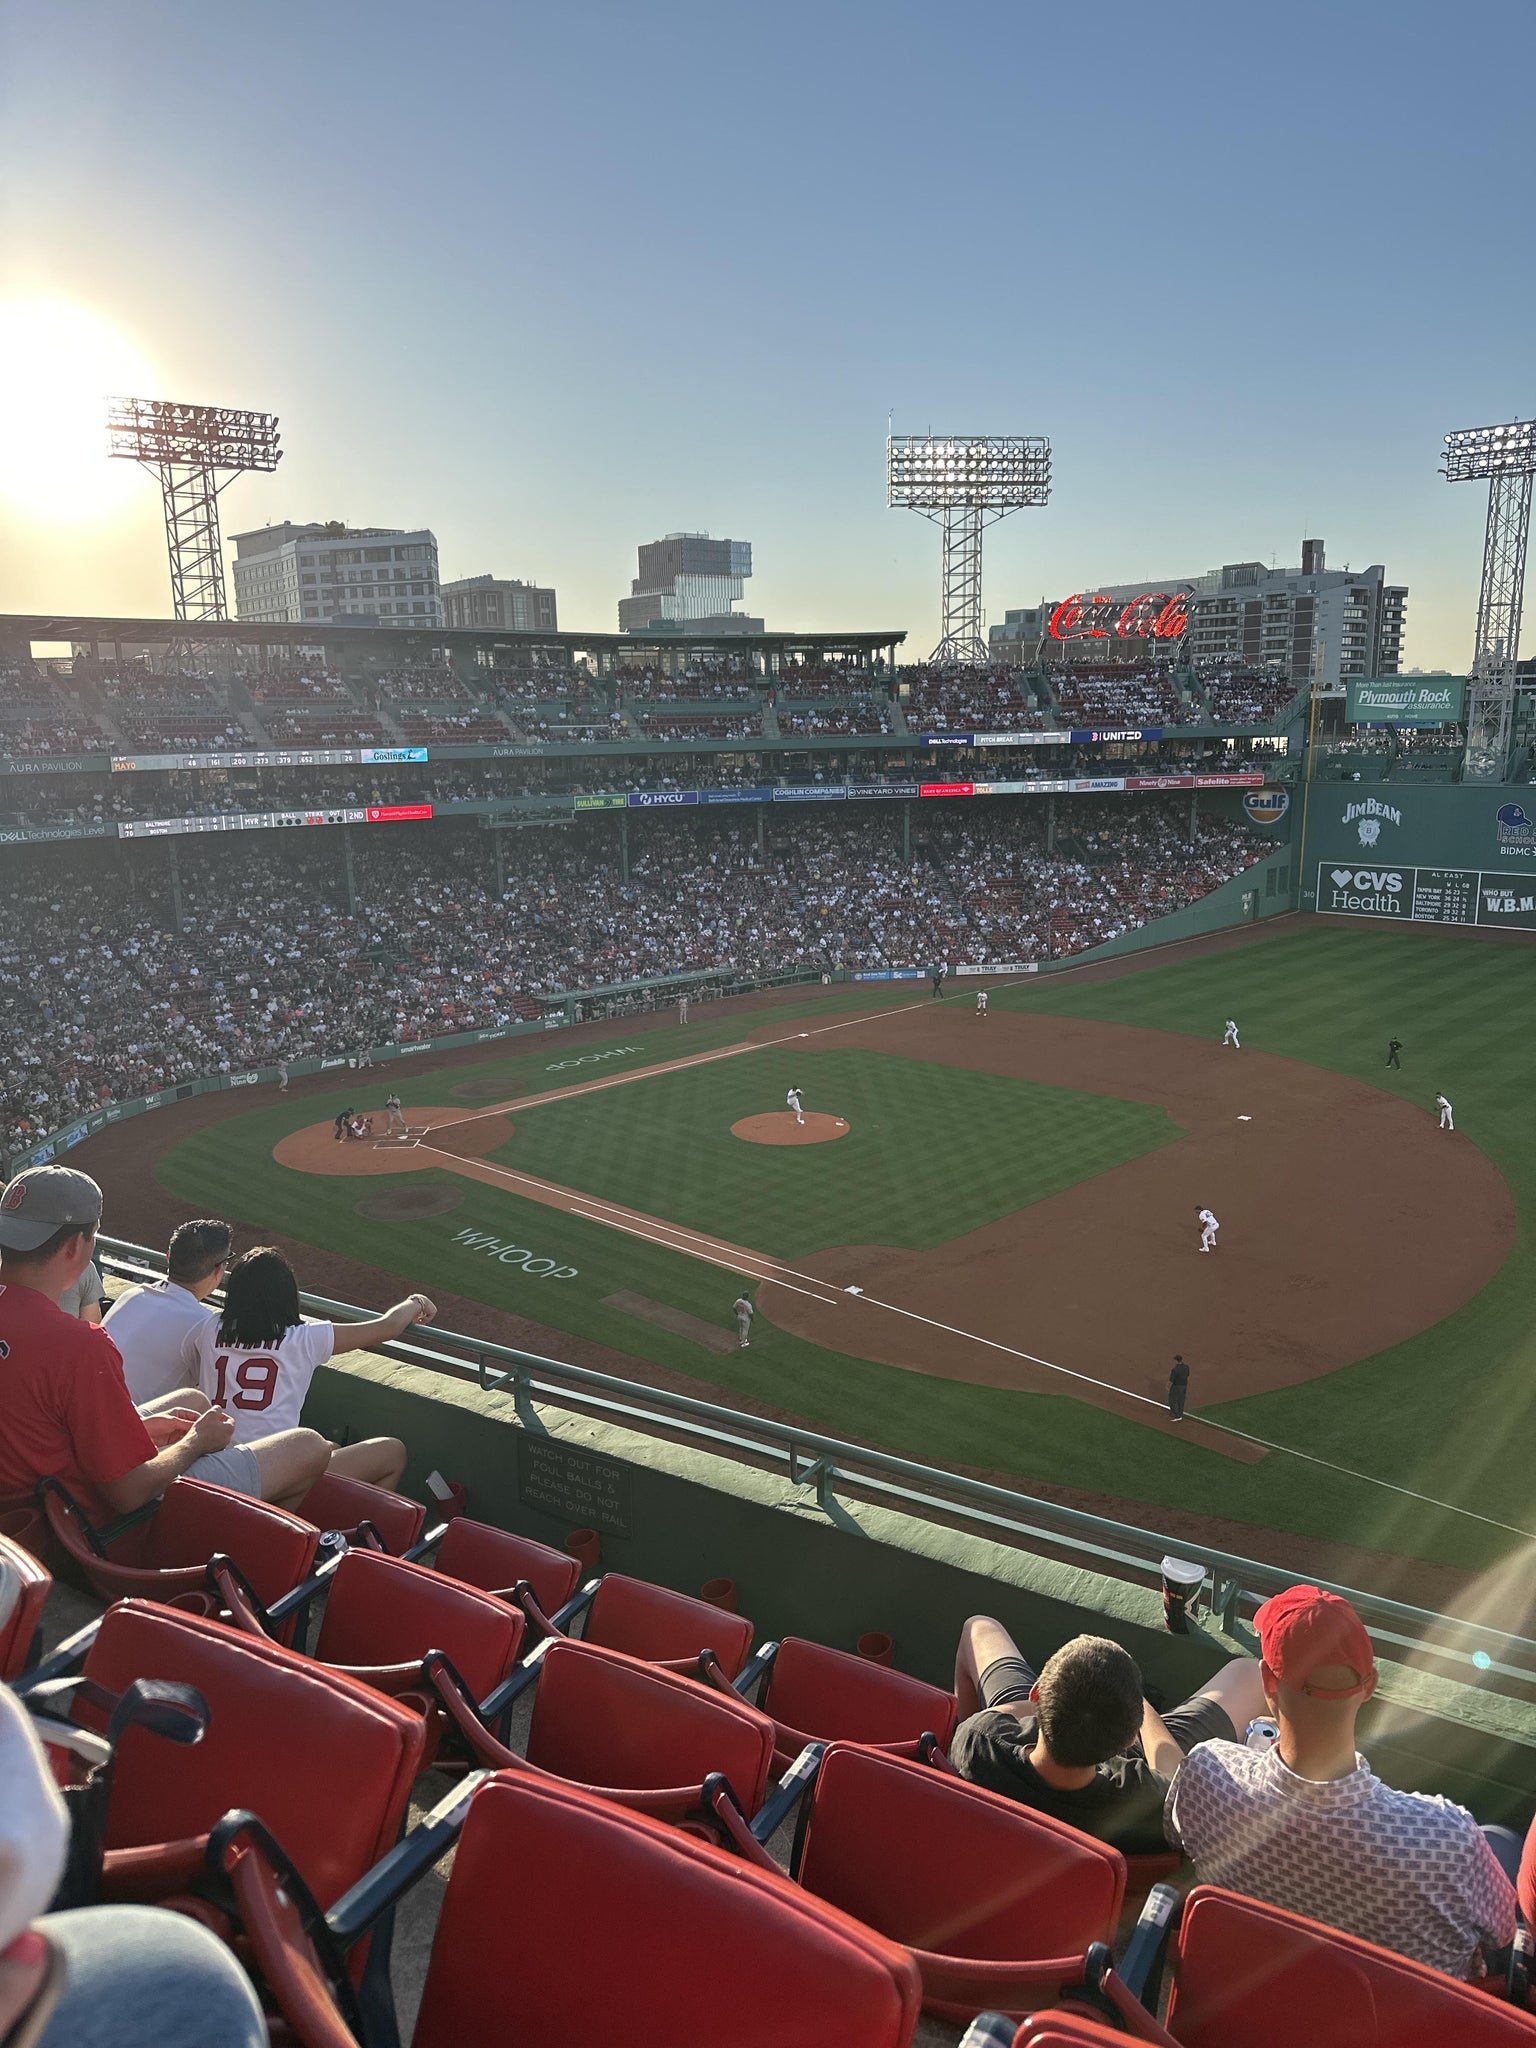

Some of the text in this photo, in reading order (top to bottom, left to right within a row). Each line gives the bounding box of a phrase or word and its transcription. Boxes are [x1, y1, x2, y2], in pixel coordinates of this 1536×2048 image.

[1358, 688, 1451, 704] Plymouth Rock
[1103, 731, 1142, 740] UNITED
[374, 752, 406, 761] Goslings
[41, 762, 81, 771] PAVILION
[654, 795, 683, 803] HYCU
[1244, 794, 1286, 809] Gulf
[349, 812, 364, 820] 2ND
[1342, 797, 1402, 826] JIM BEAM
[1, 826, 105, 842] DELL Technologies Level
[1503, 826, 1529, 836] RED
[1501, 846, 1530, 856] BIDMC
[1353, 871, 1402, 892] CVS
[1331, 890, 1400, 913] Health
[1487, 896, 1536, 913] W.B.M
[401, 1043, 432, 1053] smartwater
[321, 1058, 345, 1069] Franklin
[545, 1046, 645, 1071] WHOOP
[4, 1184, 26, 1210] B
[451, 1228, 578, 1279] WHOOP
[212, 1355, 279, 1411] 19
[528, 1443, 620, 1480] WATCH OUT FOR
[533, 1460, 615, 1494] FOUL BALLS &
[530, 1473, 620, 1510] PLEASE DO NOT
[525, 1486, 627, 1528] REACH OVER RAIL
